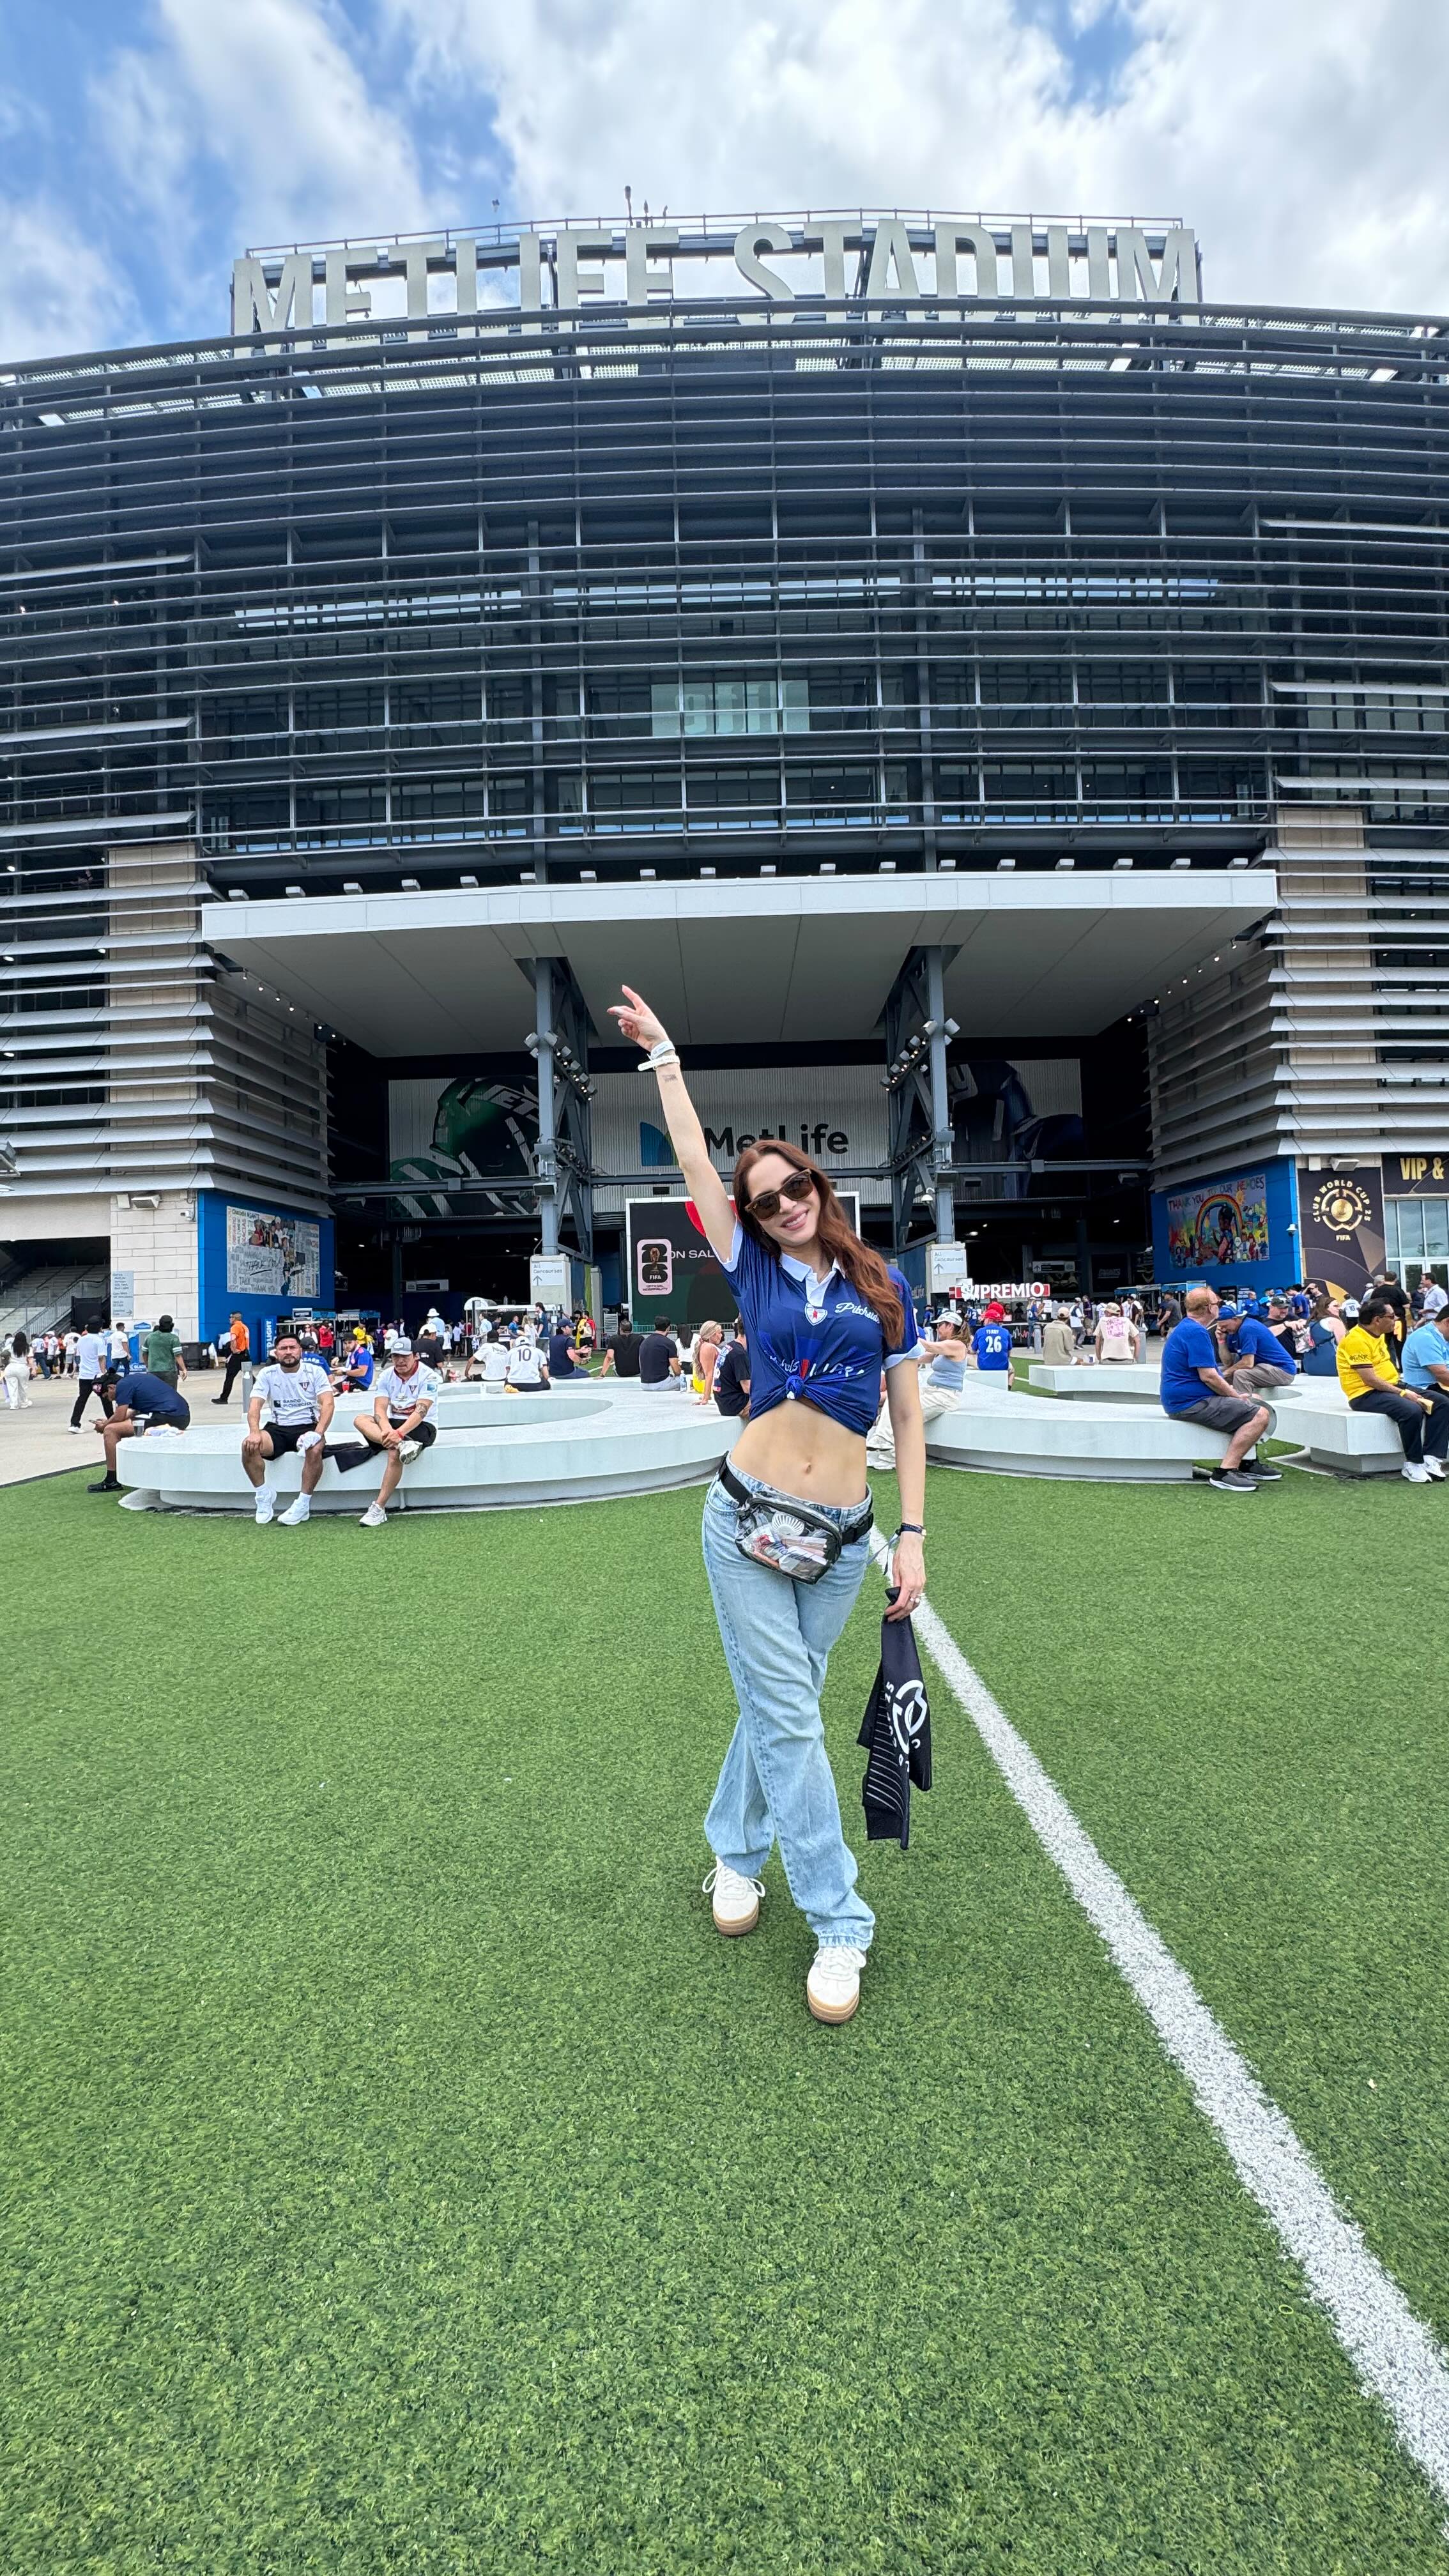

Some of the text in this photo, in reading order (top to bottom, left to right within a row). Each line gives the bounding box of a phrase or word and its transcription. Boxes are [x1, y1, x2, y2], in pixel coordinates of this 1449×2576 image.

[233, 219, 1195, 356] METLIFE STADIUM
[1400, 1157, 1445, 1180] VIP &
[1192, 1193, 1204, 1206] YOU
[1220, 1184, 1233, 1193] OUR
[1237, 1176, 1265, 1191] HEROES
[1312, 1179, 1372, 1223] CLUB WORLD CUP 25
[962, 1282, 1045, 1300] SUPREMIO
[518, 1348, 532, 1361] 10
[985, 1336, 1002, 1353] 26
